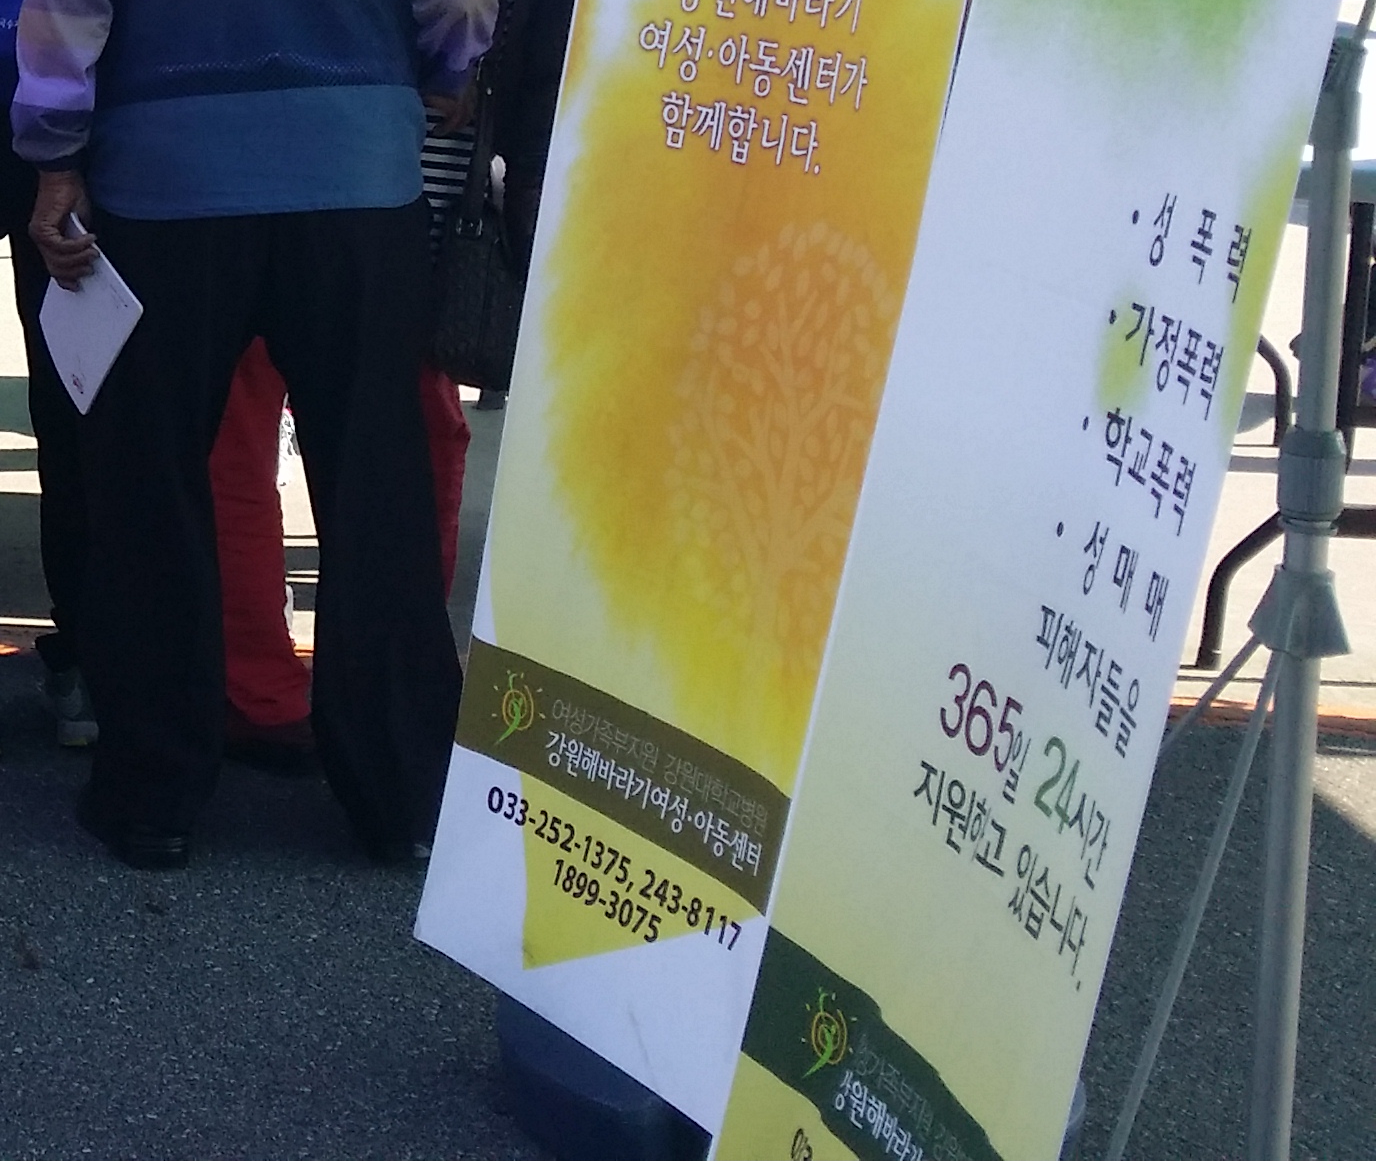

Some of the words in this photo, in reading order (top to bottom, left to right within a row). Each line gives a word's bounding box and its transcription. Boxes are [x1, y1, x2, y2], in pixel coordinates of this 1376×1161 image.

[638, 19, 869, 111] 여성·아동센터가
[661, 91, 821, 175] 함께합니다.
[1125, 301, 1225, 421] 가정폭력
[1103, 407, 1199, 537] 학교폭력
[1035, 603, 1141, 759] 피해자들을
[545, 731, 762, 877] 강원해바라기여성·아동센터
[939, 662, 1032, 805] 365일
[1033, 735, 1112, 890] 24시간
[486, 785, 636, 893] 033-252-1375,
[638, 868, 743, 951] 243-8117
[552, 858, 663, 944] 1899-3075
[913, 759, 1007, 878] 지원하고
[1007, 843, 1089, 993] 있습니다.
